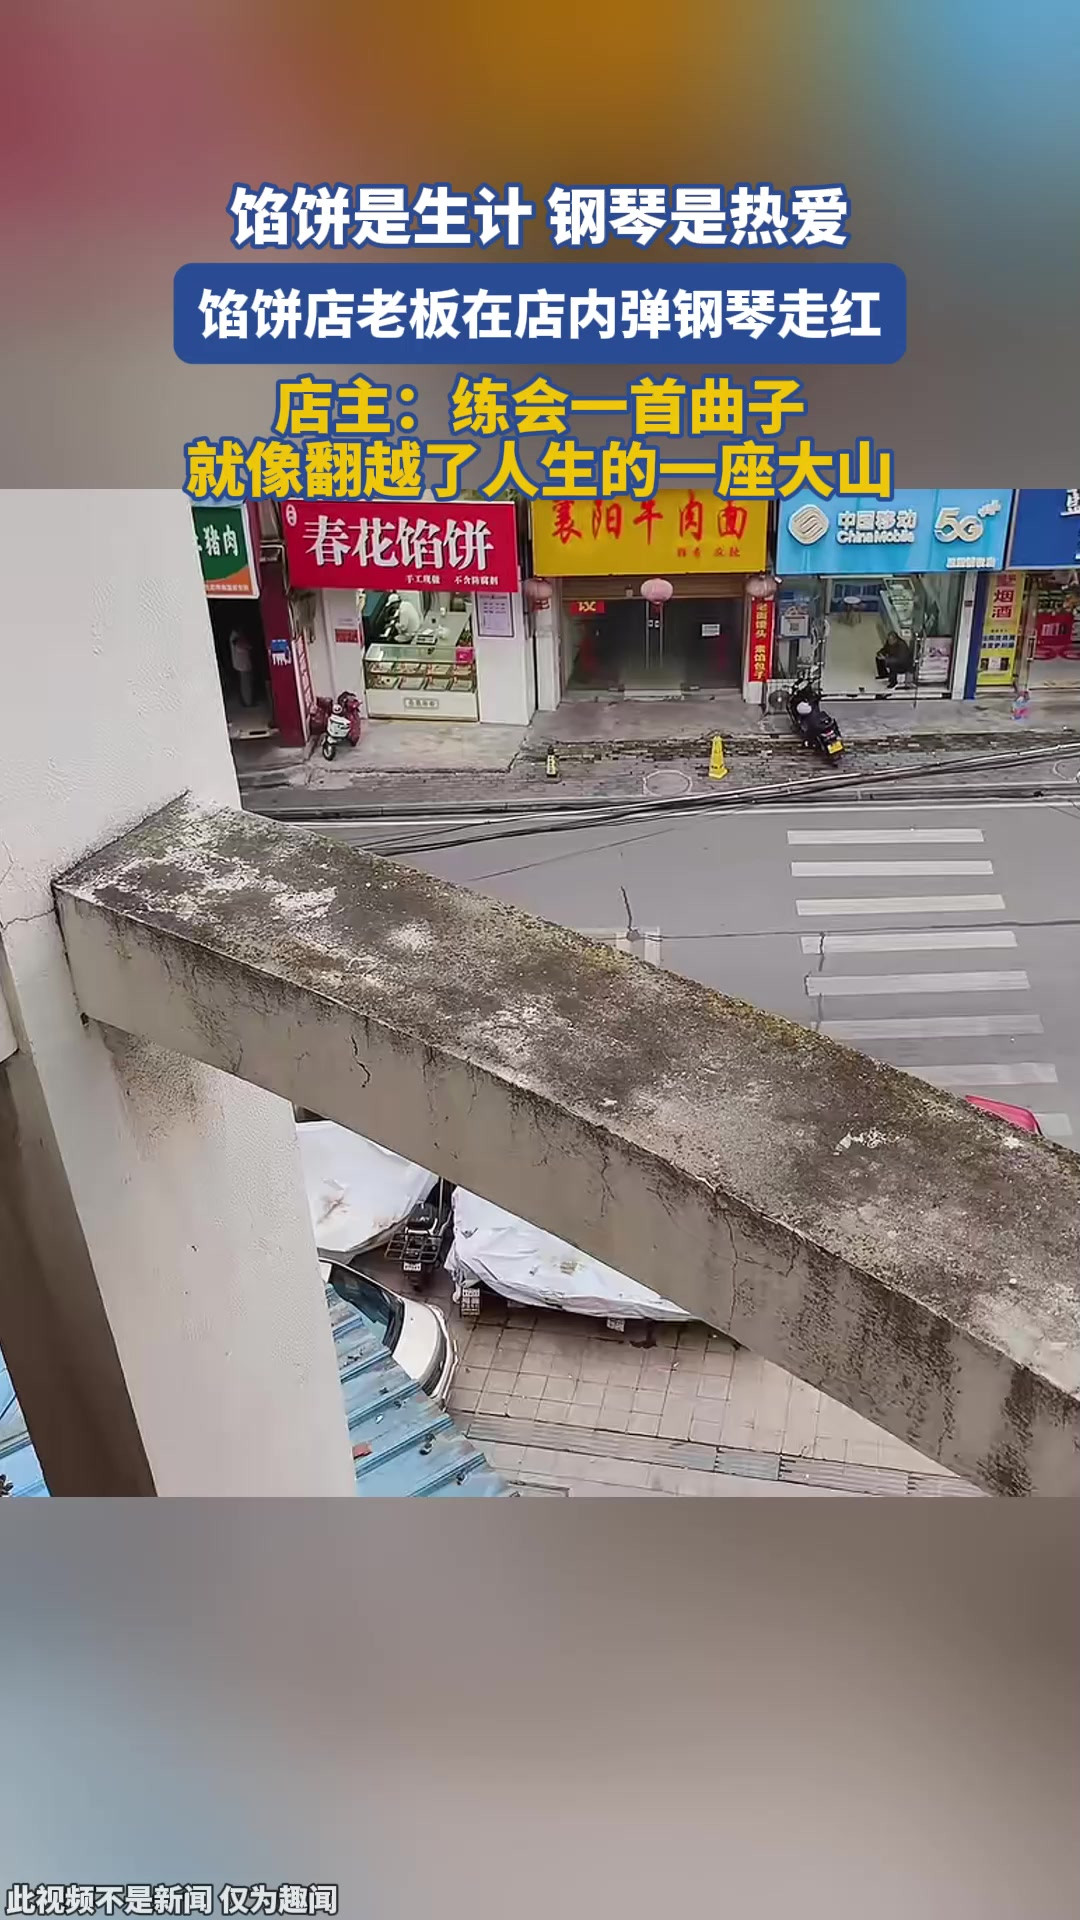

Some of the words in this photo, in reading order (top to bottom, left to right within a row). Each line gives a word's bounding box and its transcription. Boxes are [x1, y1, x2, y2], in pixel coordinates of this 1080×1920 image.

[837, 509, 917, 530] 中国移动
[193, 524, 239, 556] 猪肉
[302, 515, 494, 571] 春花馅饼
[992, 589, 1014, 618] 烟酒
